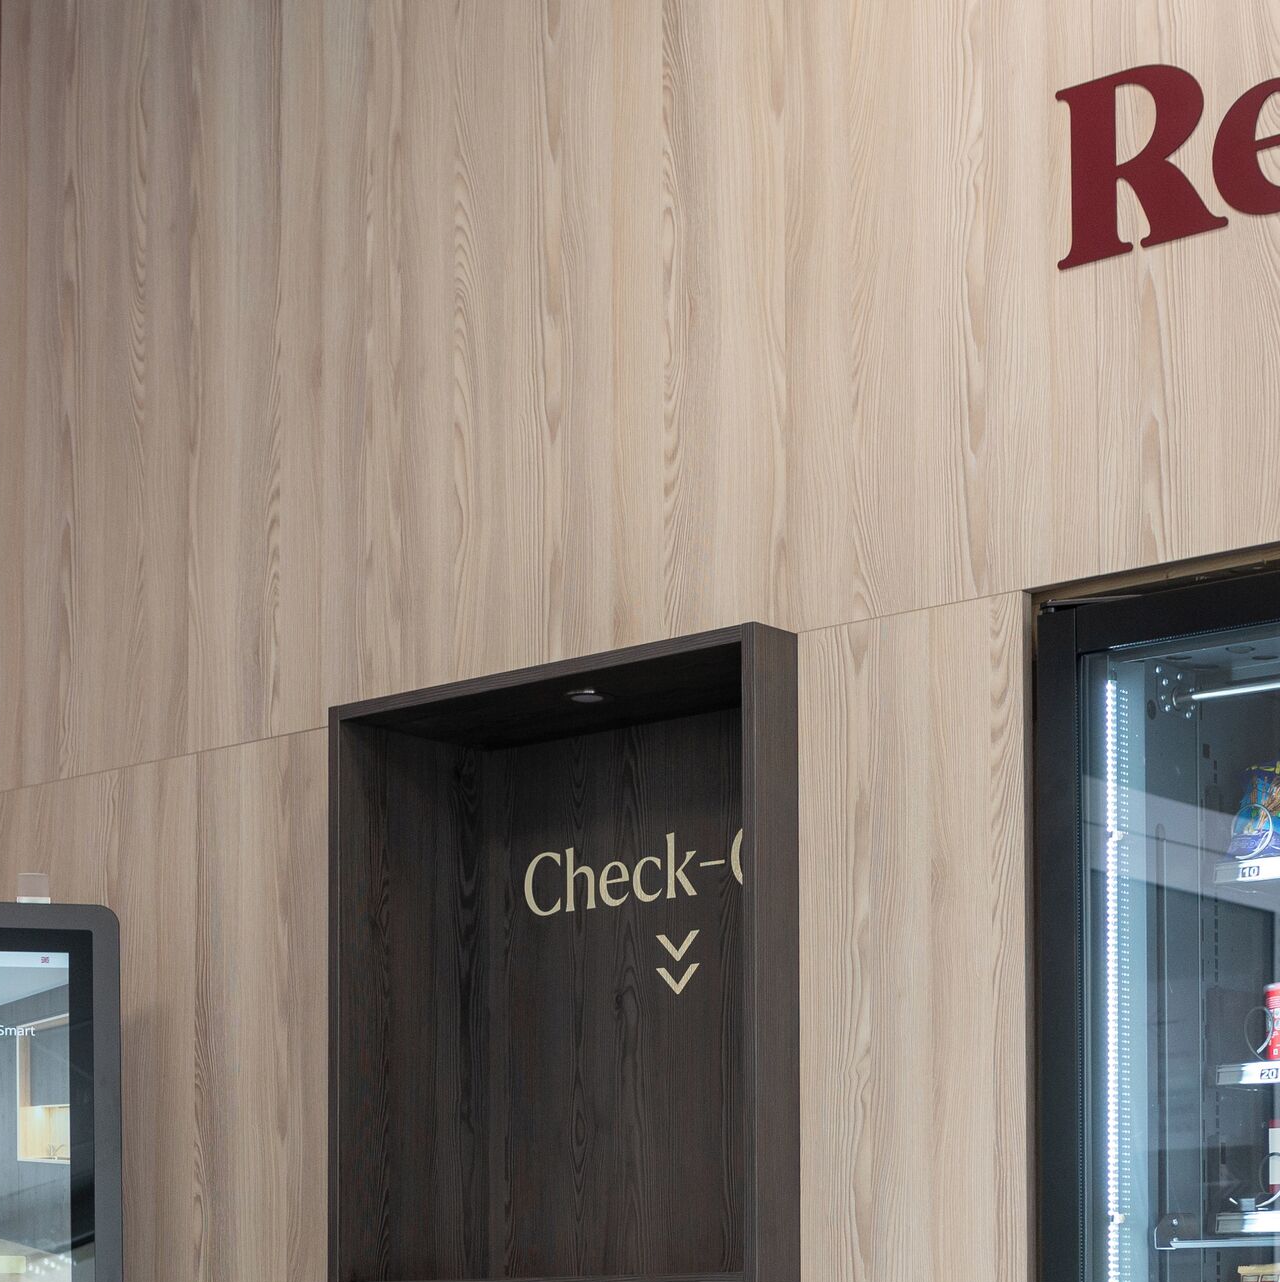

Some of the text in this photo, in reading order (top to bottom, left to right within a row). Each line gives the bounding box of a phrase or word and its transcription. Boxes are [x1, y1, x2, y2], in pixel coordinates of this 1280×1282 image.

[523, 828, 743, 916] Check-
[1241, 866, 1259, 878] 10
[1261, 1069, 1277, 1079] 20
